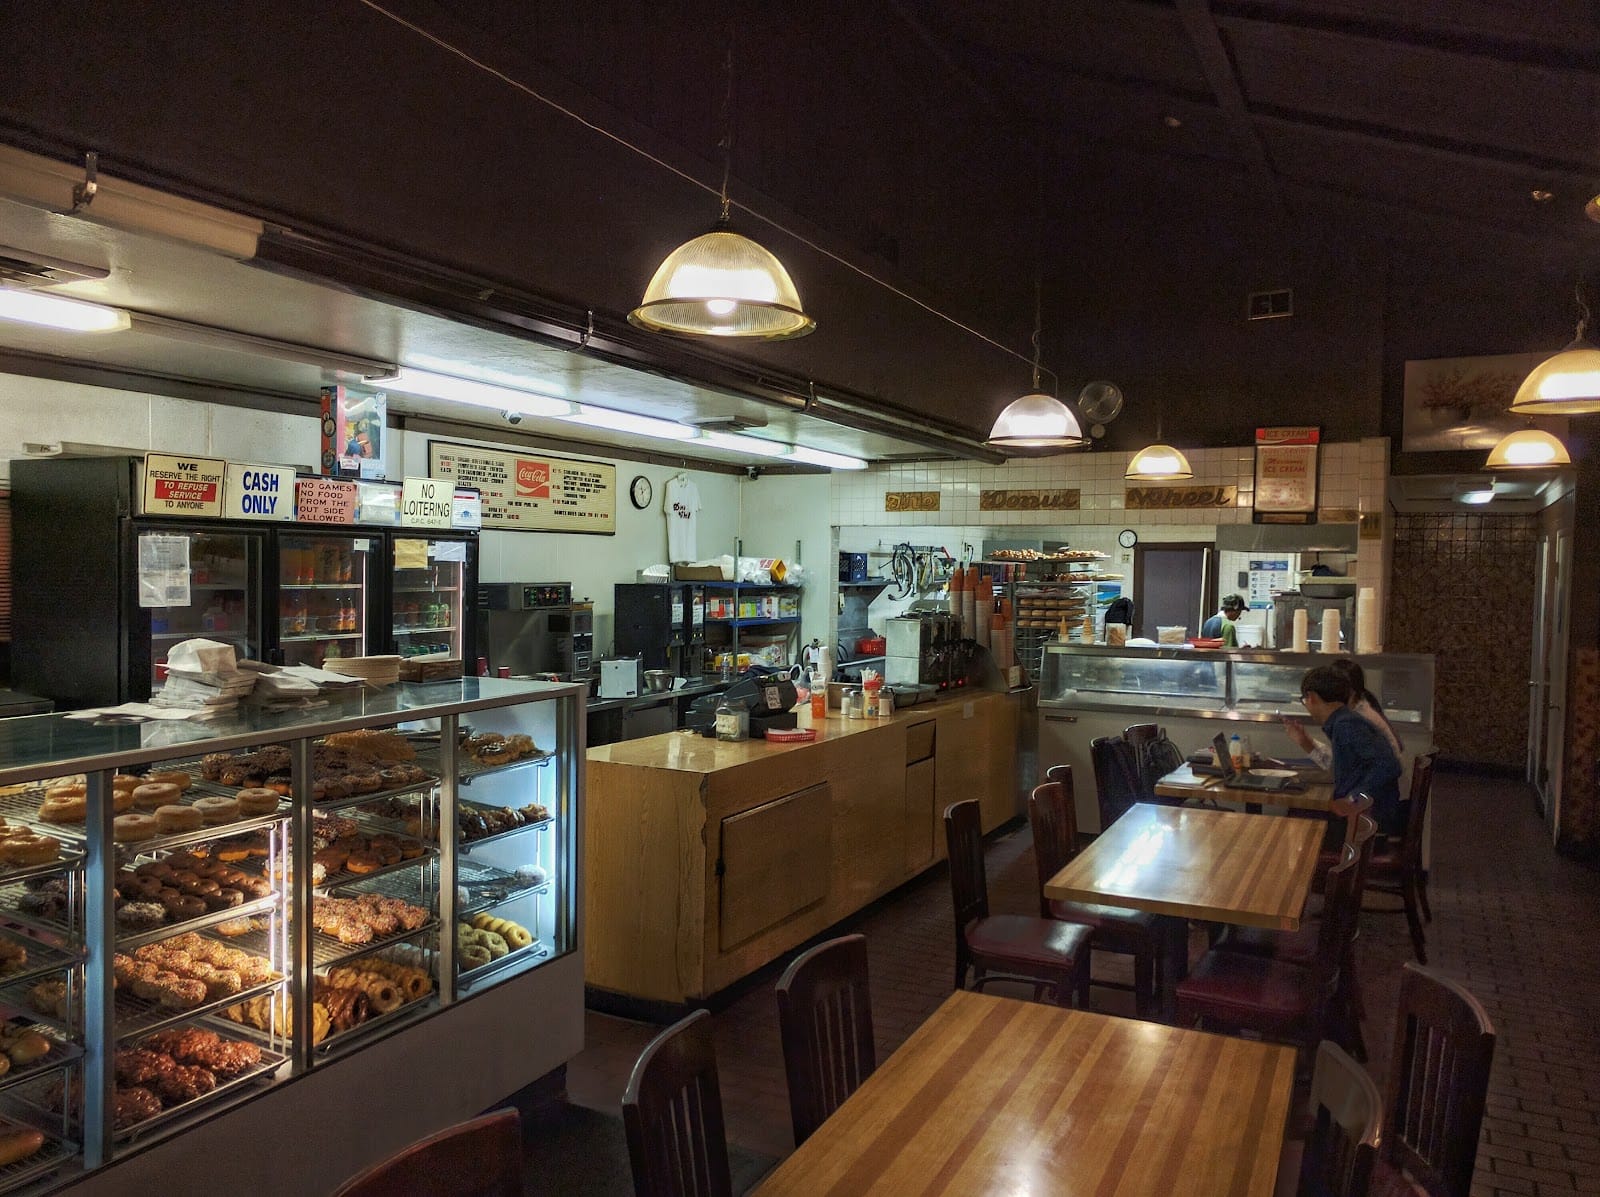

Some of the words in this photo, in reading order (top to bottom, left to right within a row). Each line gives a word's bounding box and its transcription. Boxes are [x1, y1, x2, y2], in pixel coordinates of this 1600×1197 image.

[177, 462, 199, 472] WE
[149, 470, 183, 480] RESERVE
[186, 473, 199, 481] THE
[201, 474, 222, 483] RIGHT
[243, 471, 279, 492] CASH
[163, 481, 175, 489] TO
[177, 482, 209, 492] REFUSE
[318, 483, 352, 492] GAMES
[421, 484, 435, 499] NO
[168, 490, 203, 500] SERVICE
[318, 491, 343, 499] FOOD
[982, 490, 1078, 509] Donut
[1126, 487, 1231, 506] Wheel
[165, 500, 174, 508] TO
[176, 501, 204, 510] ANYONE
[241, 494, 278, 514] ONLY
[300, 498, 327, 506] FROM
[403, 500, 450, 518] LOITERING
[300, 514, 345, 523] ALLOWED
